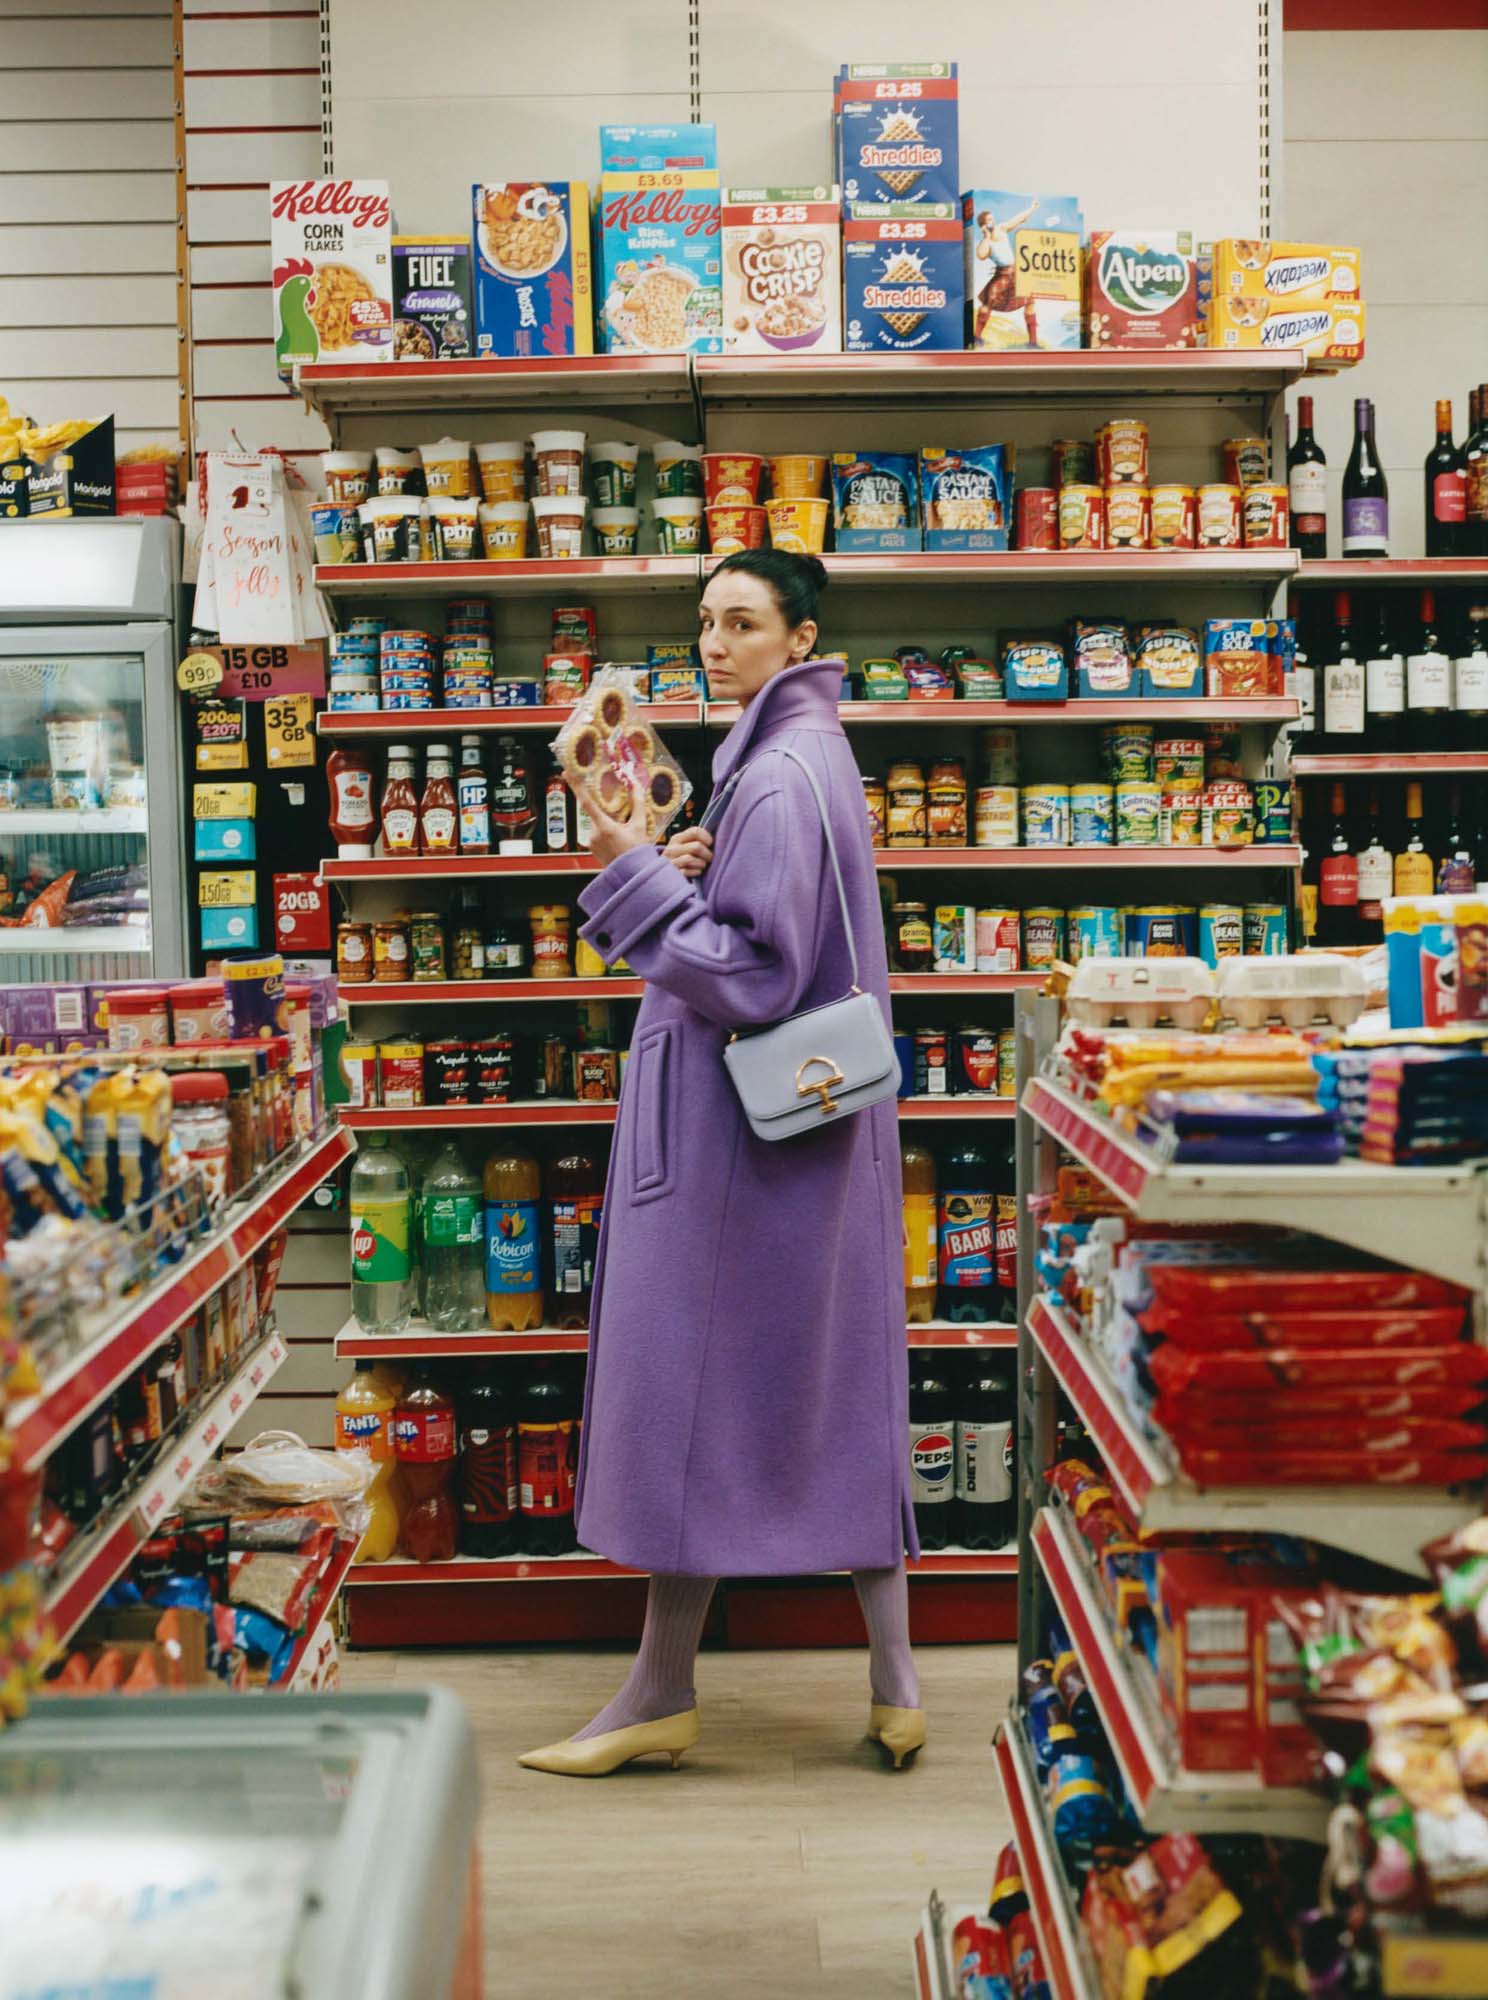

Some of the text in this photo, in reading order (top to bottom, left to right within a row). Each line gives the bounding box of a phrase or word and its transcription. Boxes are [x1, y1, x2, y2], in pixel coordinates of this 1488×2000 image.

[875, 82, 922, 98] £3.25
[860, 145, 942, 167] Shreddies
[637, 174, 683, 187] £3.69
[752, 206, 808, 223] £3.25
[303, 224, 344, 240] CORN
[878, 223, 927, 239] £3.25
[304, 241, 344, 251] FLAKES
[1019, 245, 1077, 273] Scott's
[408, 256, 455, 288] FUEL
[576, 252, 589, 295] £3.69
[1104, 251, 1183, 288] Alpen
[1265, 259, 1328, 288] Weetabix
[405, 291, 461, 311] Granola
[863, 286, 946, 309] Shreddies
[1262, 313, 1330, 345] Weetabix
[74, 482, 112, 497] Marigold
[850, 491, 904, 505] SAUCE
[939, 486, 992, 500] SAUCE
[219, 526, 281, 558] Season
[604, 537, 634, 550] POT
[1222, 631, 1244, 641] CUP
[655, 647, 691, 658] SPAM
[1222, 641, 1253, 650] SOUP
[1012, 648, 1058, 661] SUPER
[185, 667, 215, 684] 99p
[241, 672, 272, 688] £10
[658, 673, 696, 683] SPAM
[267, 707, 298, 729] 35
[202, 724, 240, 737] £20?!
[282, 728, 306, 742] GB
[462, 787, 487, 804] HP
[196, 797, 220, 815] 20GB
[201, 885, 232, 903] 150GB
[278, 891, 320, 911] 20GB
[490, 1236, 534, 1257] Rubicon
[950, 1226, 993, 1255] BARR
[343, 1414, 381, 1432] FANTA
[967, 1453, 976, 1492] DIET
